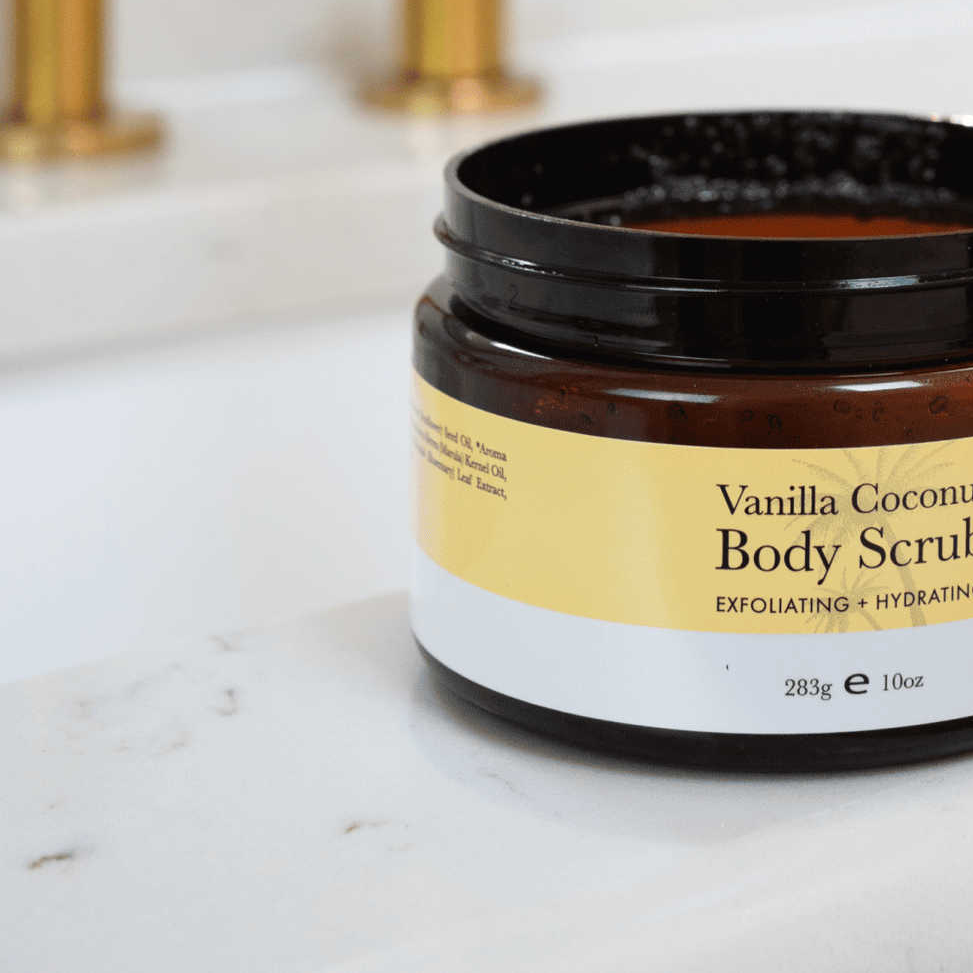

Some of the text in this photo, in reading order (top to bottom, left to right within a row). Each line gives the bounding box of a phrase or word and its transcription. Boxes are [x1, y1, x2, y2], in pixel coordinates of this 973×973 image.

[465, 454, 489, 474] Kernel
[491, 464, 507, 482] Oil,
[457, 468, 507, 500] Leaf Extract,
[716, 483, 839, 516] Vanilla
[715, 528, 842, 586] Body
[716, 596, 850, 614] EXFOLIATING
[784, 678, 833, 701] 283g
[882, 673, 924, 691] 10oz
